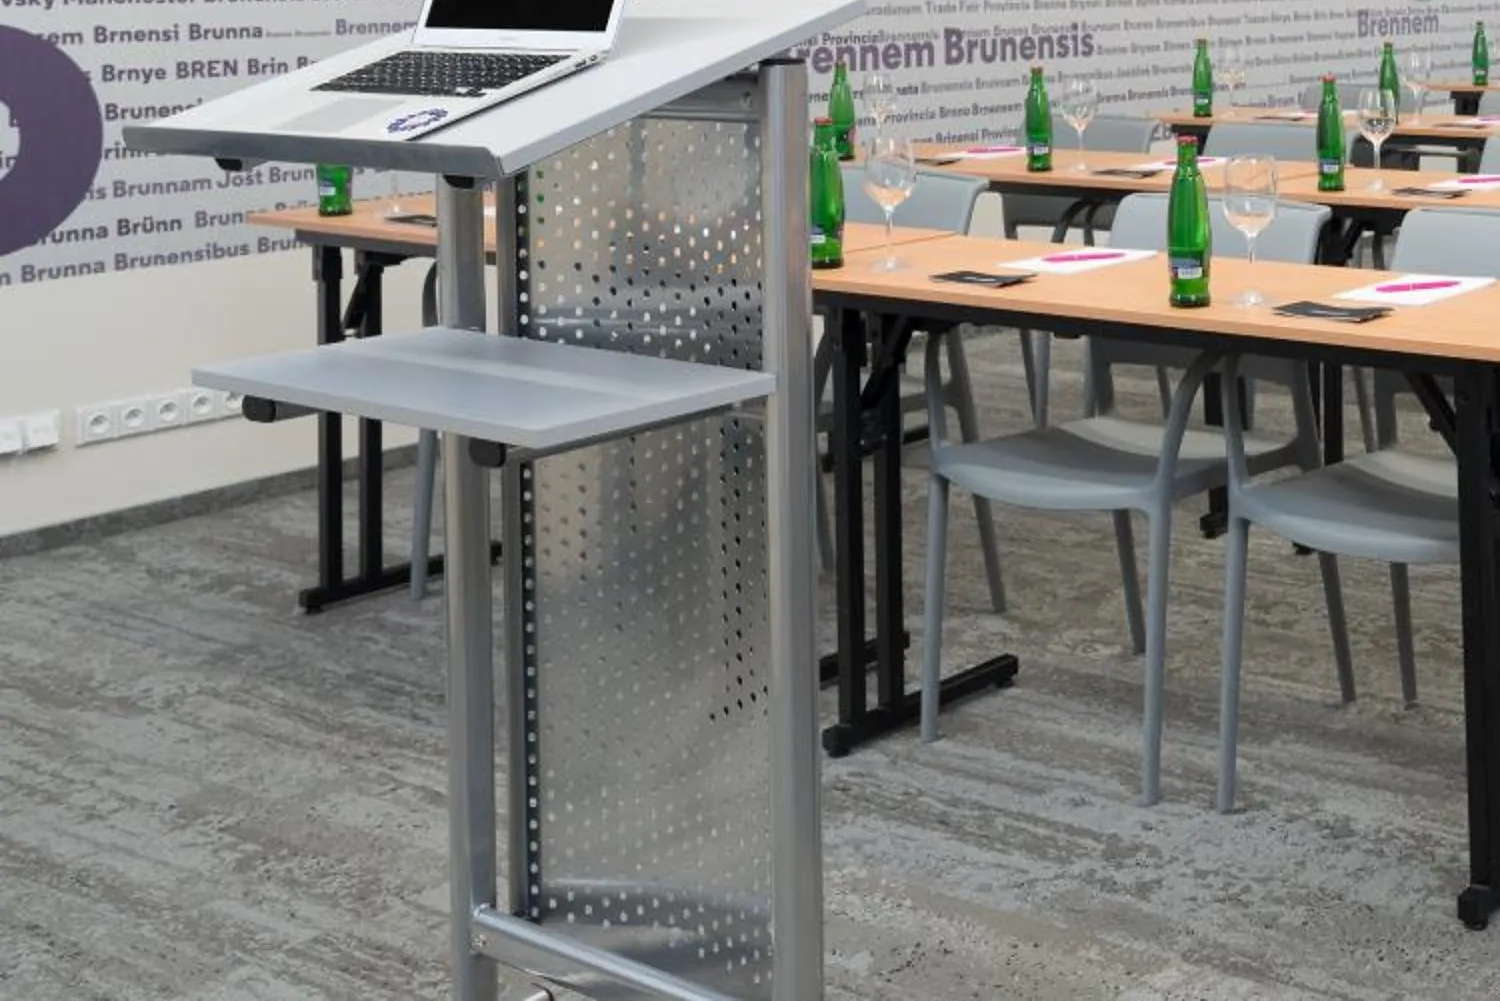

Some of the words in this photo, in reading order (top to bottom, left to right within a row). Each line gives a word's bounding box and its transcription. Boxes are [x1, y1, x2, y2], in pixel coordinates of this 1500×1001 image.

[93, 23, 179, 44] Brnensi
[188, 22, 263, 41] Brunna
[1357, 9, 1439, 37] Brennem
[799, 36, 934, 75] rennem
[943, 26, 1098, 65] Brunensis
[101, 63, 167, 84] Brnye
[175, 58, 238, 79] BREN
[247, 56, 289, 76] Brin
[111, 177, 212, 198] Brunnam
[116, 215, 182, 237] Brünn
[20, 260, 106, 283] Brunna
[113, 242, 250, 272] Brunensibus
